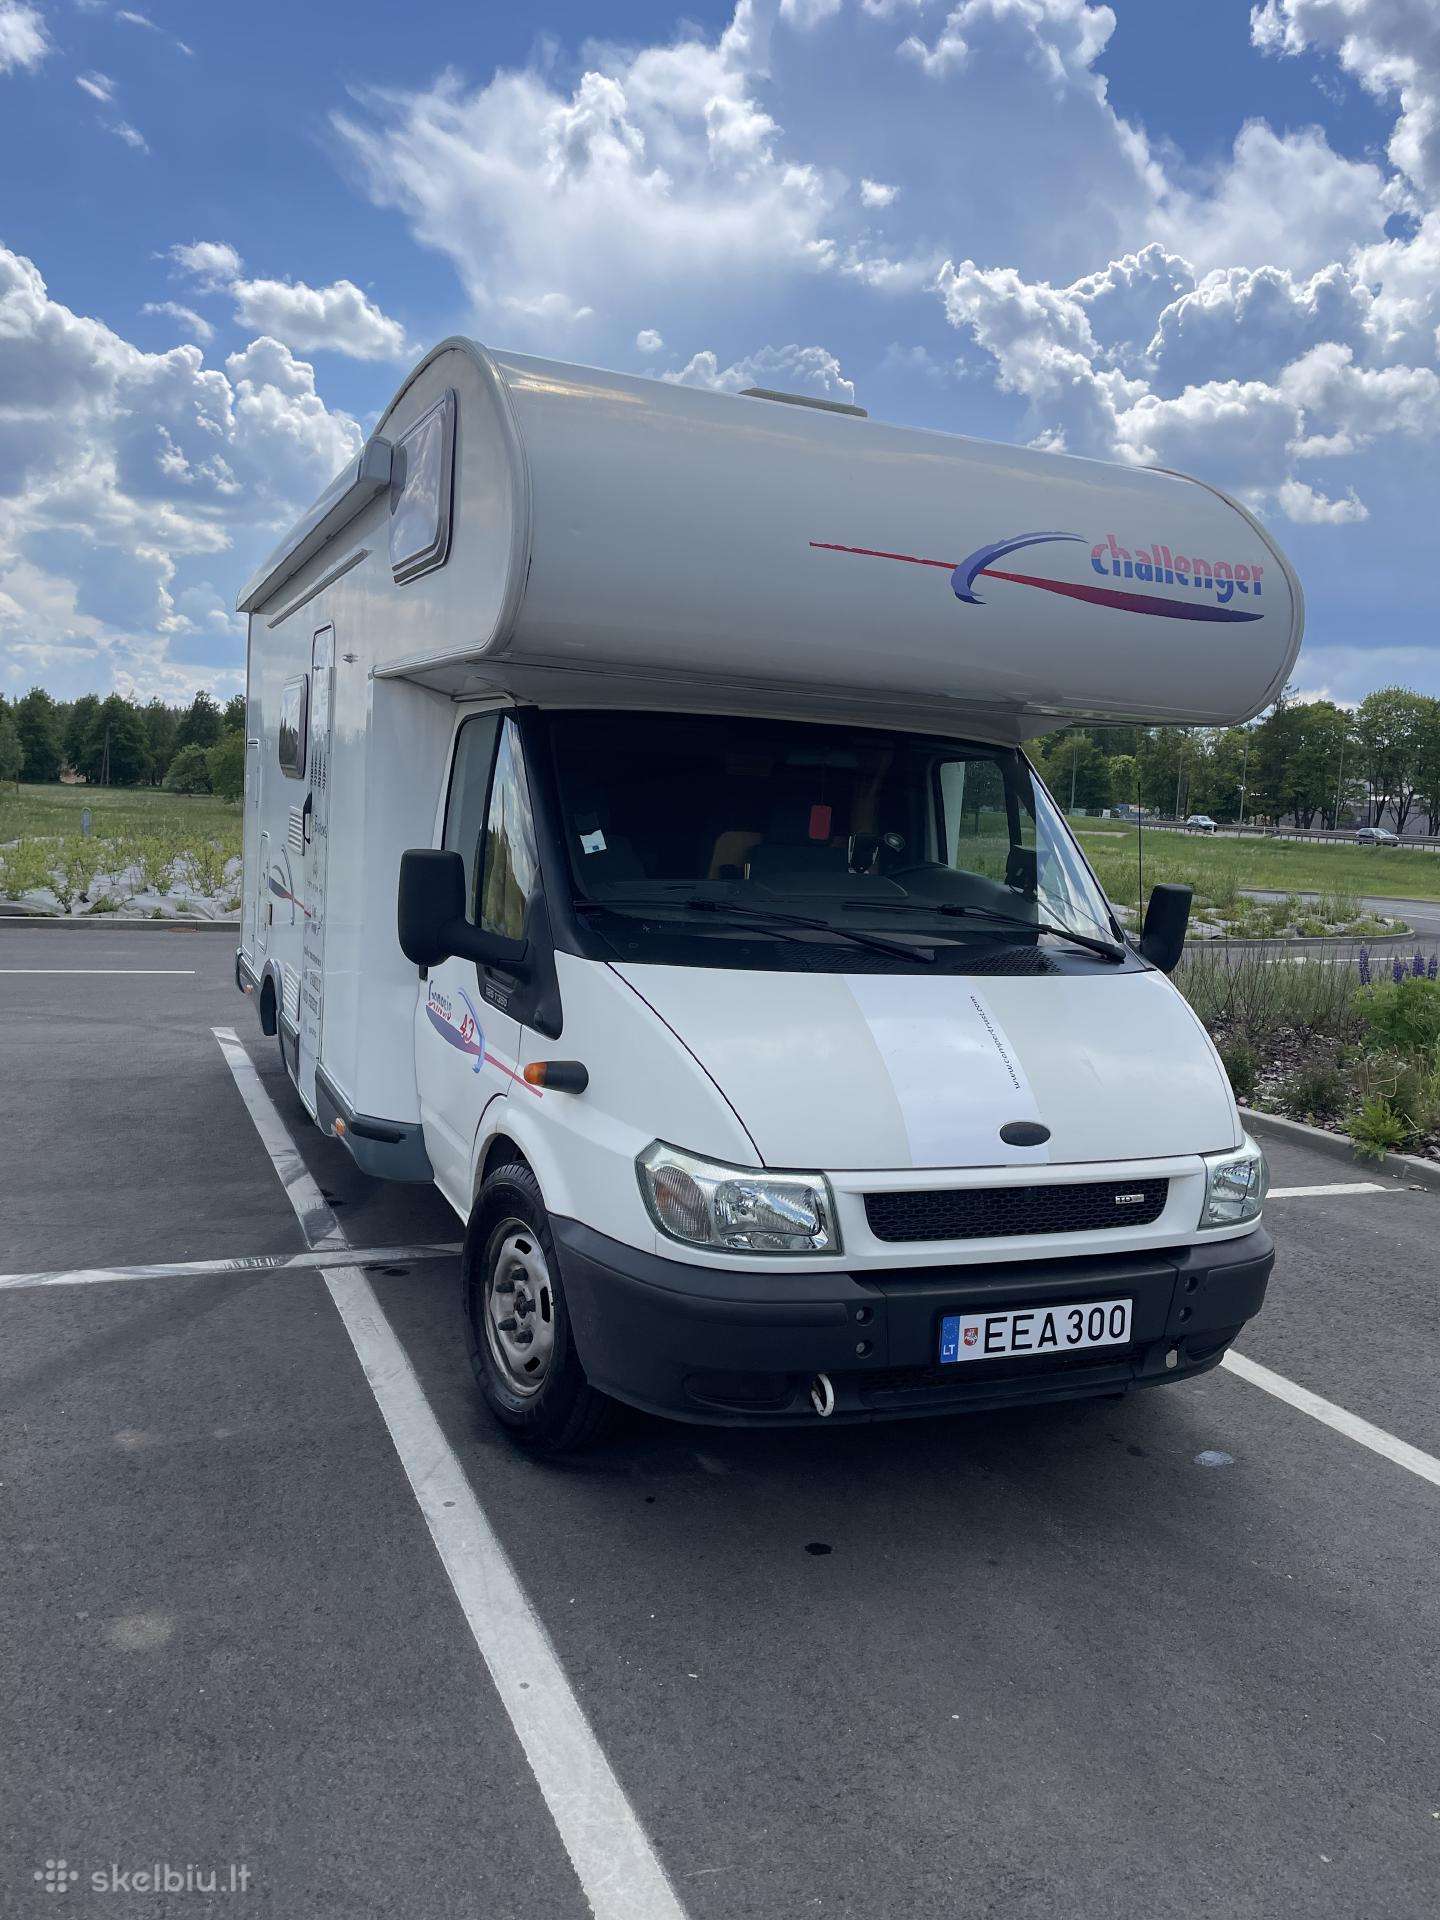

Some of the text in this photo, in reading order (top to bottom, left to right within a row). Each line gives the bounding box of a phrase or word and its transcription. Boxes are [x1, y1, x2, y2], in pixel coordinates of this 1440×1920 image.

[1091, 534, 1264, 603] challenger
[460, 1014, 475, 1044] 43
[984, 1304, 1126, 1353] EEA 300
[943, 1344, 956, 1356] LT
